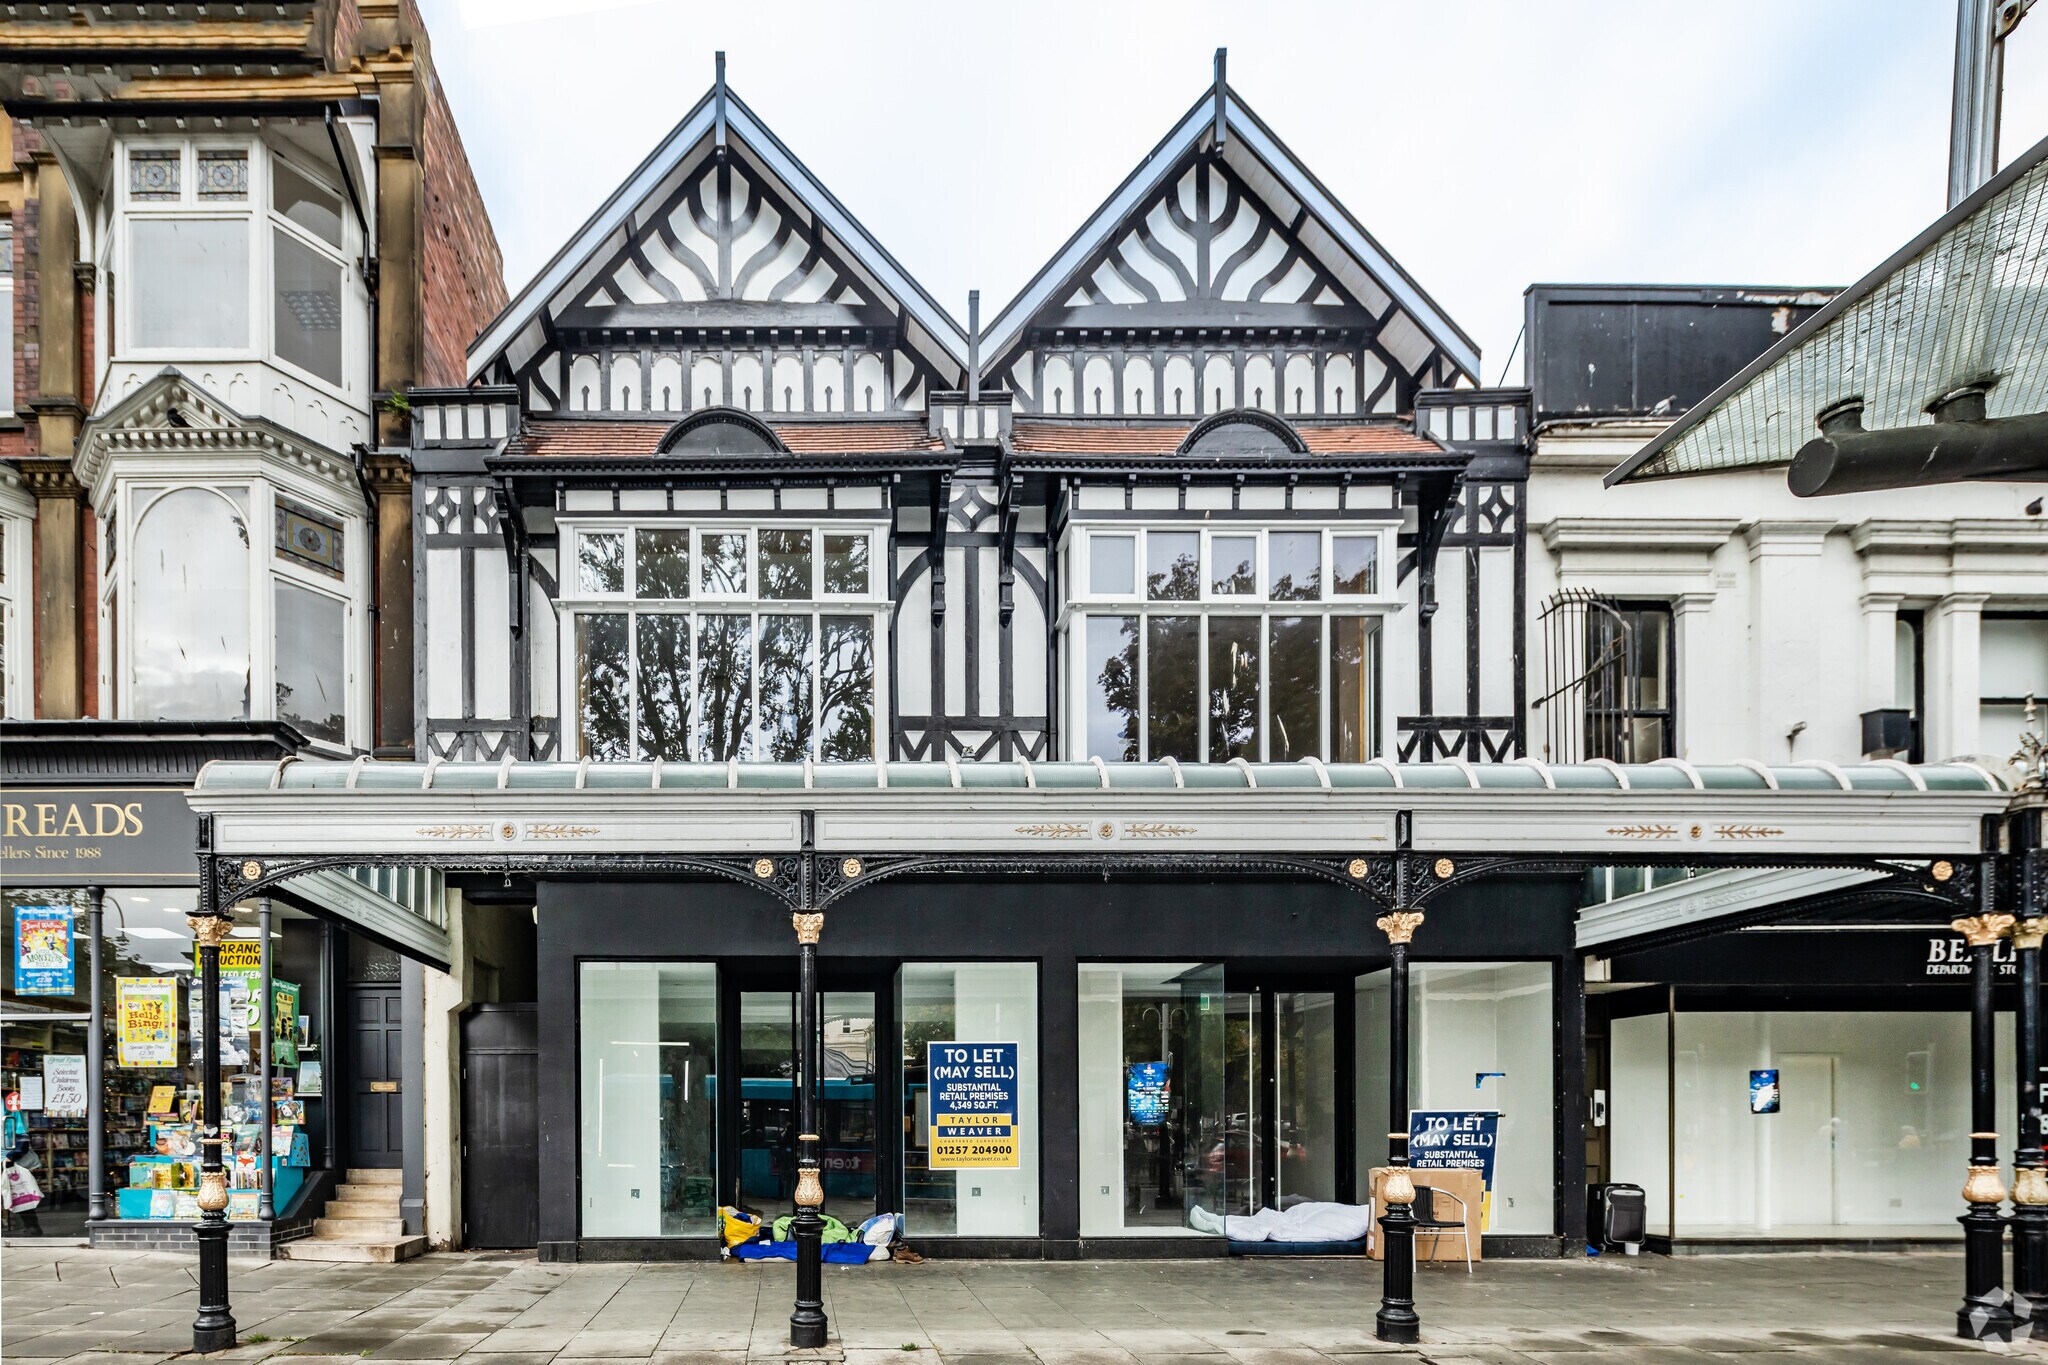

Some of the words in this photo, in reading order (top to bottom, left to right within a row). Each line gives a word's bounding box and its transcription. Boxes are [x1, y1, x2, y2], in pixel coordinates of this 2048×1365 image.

[2, 803, 144, 837] READS
[35, 845, 69, 859] Since
[75, 847, 102, 859] 1988
[129, 1011, 160, 1020] Hello
[128, 1020, 162, 1029] Bing!
[944, 1049, 968, 1063] TO
[973, 1049, 1004, 1063] LET
[934, 1066, 970, 1080] (MAY
[974, 1066, 1014, 1080] SELL)
[946, 1083, 1001, 1092] SUBSTANTIAL
[51, 1093, 81, 1104] £1.50
[940, 1092, 967, 1100] RETAIL
[969, 1092, 1008, 1100] PREMISES
[949, 1101, 972, 1110] 4,349
[1425, 1117, 1449, 1131] TO
[1453, 1117, 1485, 1131] LET
[947, 1128, 1002, 1136] WEAVER
[1413, 1134, 1450, 1148] (MAY
[1452, 1134, 1494, 1148] SELL)
[937, 1146, 968, 1155] 01257
[972, 1146, 1012, 1155] 204900
[1424, 1151, 1478, 1159] SUBSTANTIAL
[1417, 1160, 1444, 1168] RETAIL
[1445, 1160, 1485, 1168] PREMISES
